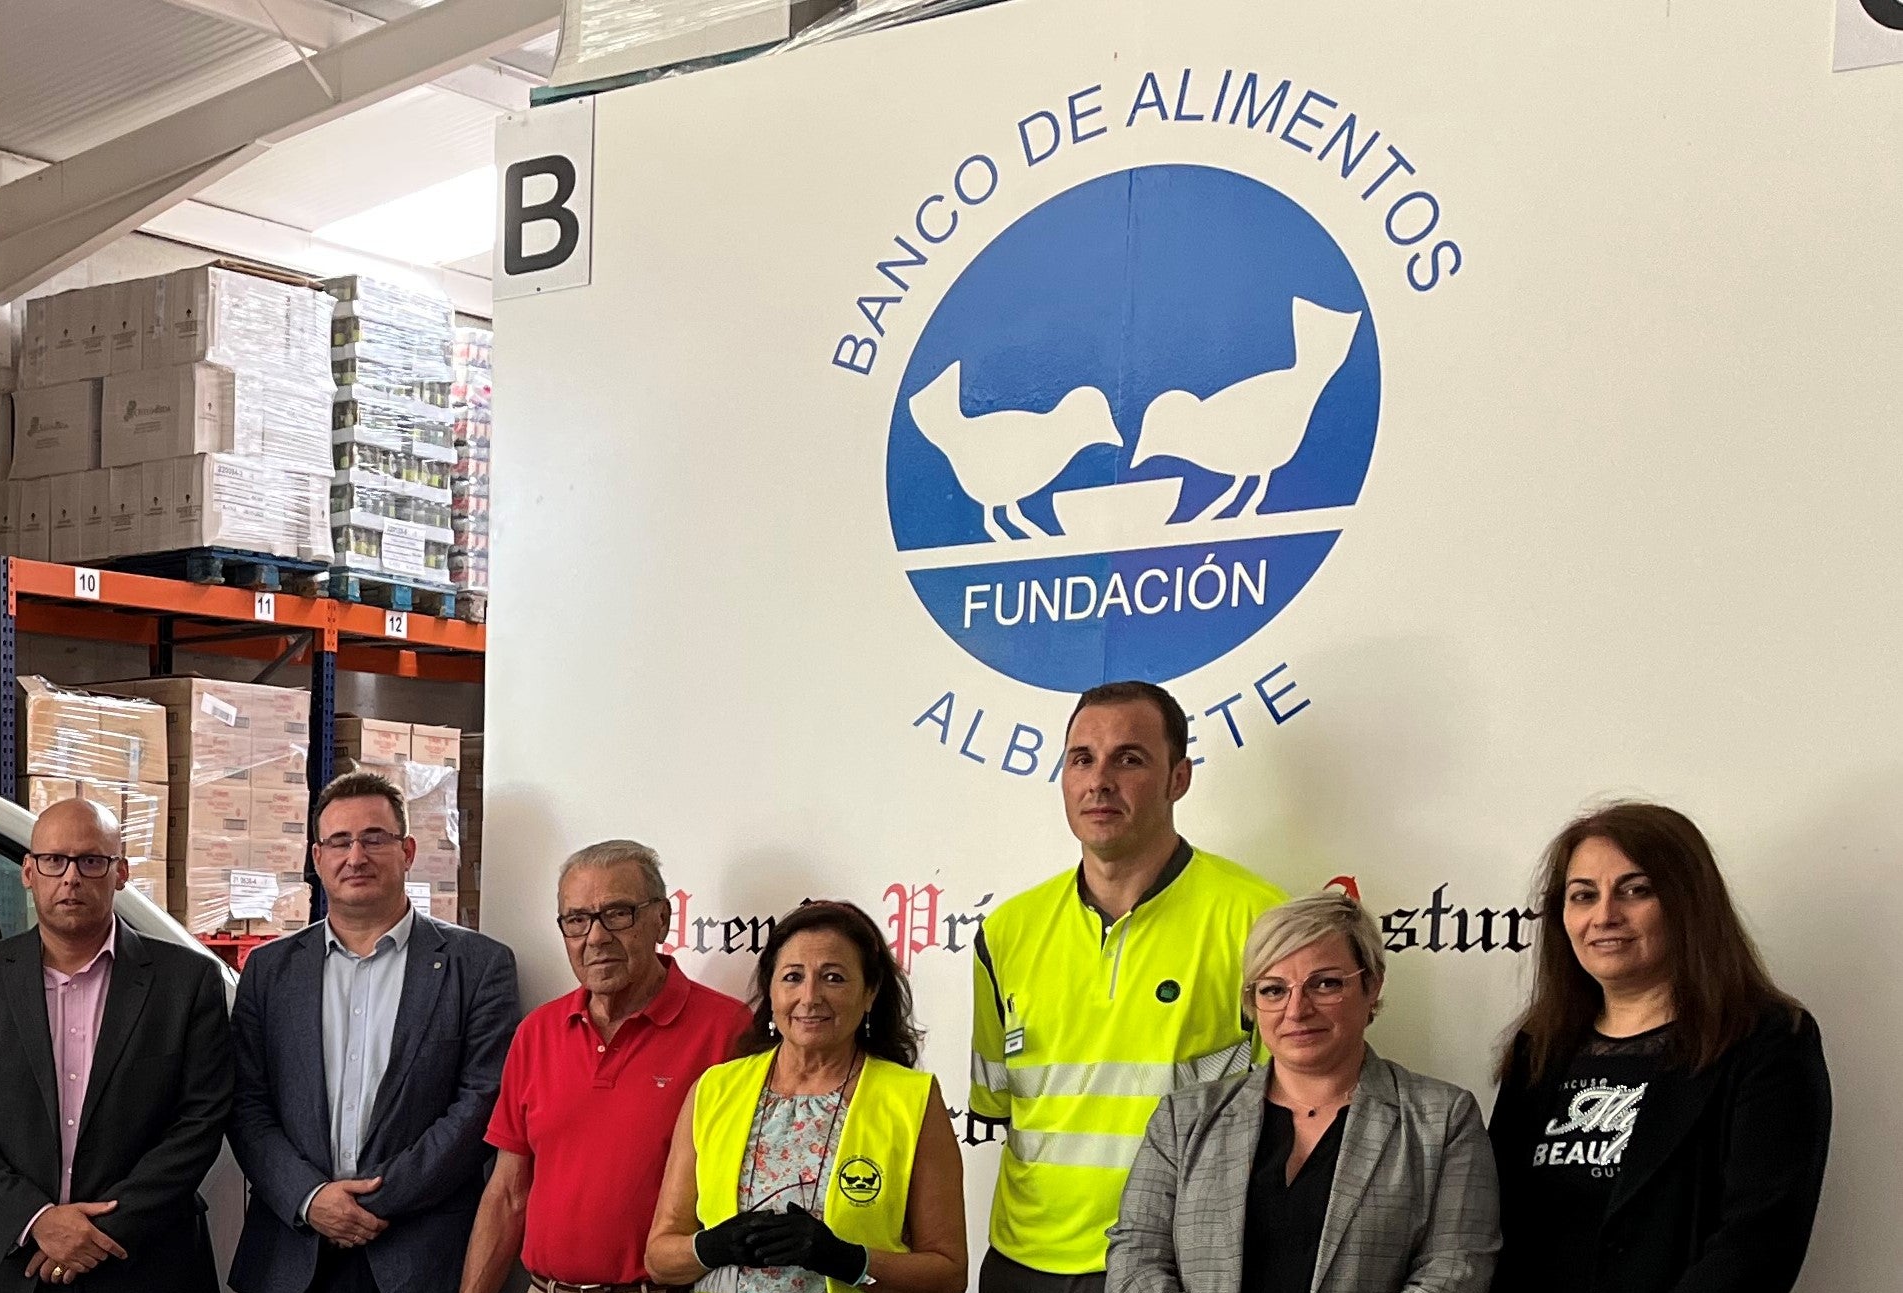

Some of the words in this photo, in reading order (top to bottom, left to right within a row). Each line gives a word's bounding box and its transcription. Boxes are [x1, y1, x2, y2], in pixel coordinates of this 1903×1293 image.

[504, 155, 579, 276] B
[832, 154, 1000, 376] BANCO
[1018, 84, 1108, 166] DE
[1126, 68, 1462, 294] ALIMENTOS
[79, 575, 96, 591] 10
[257, 598, 271, 614] 11
[963, 554, 1267, 629] FUNDACIÓN
[389, 616, 403, 632] 12
[913, 663, 1311, 783] ALBETE
